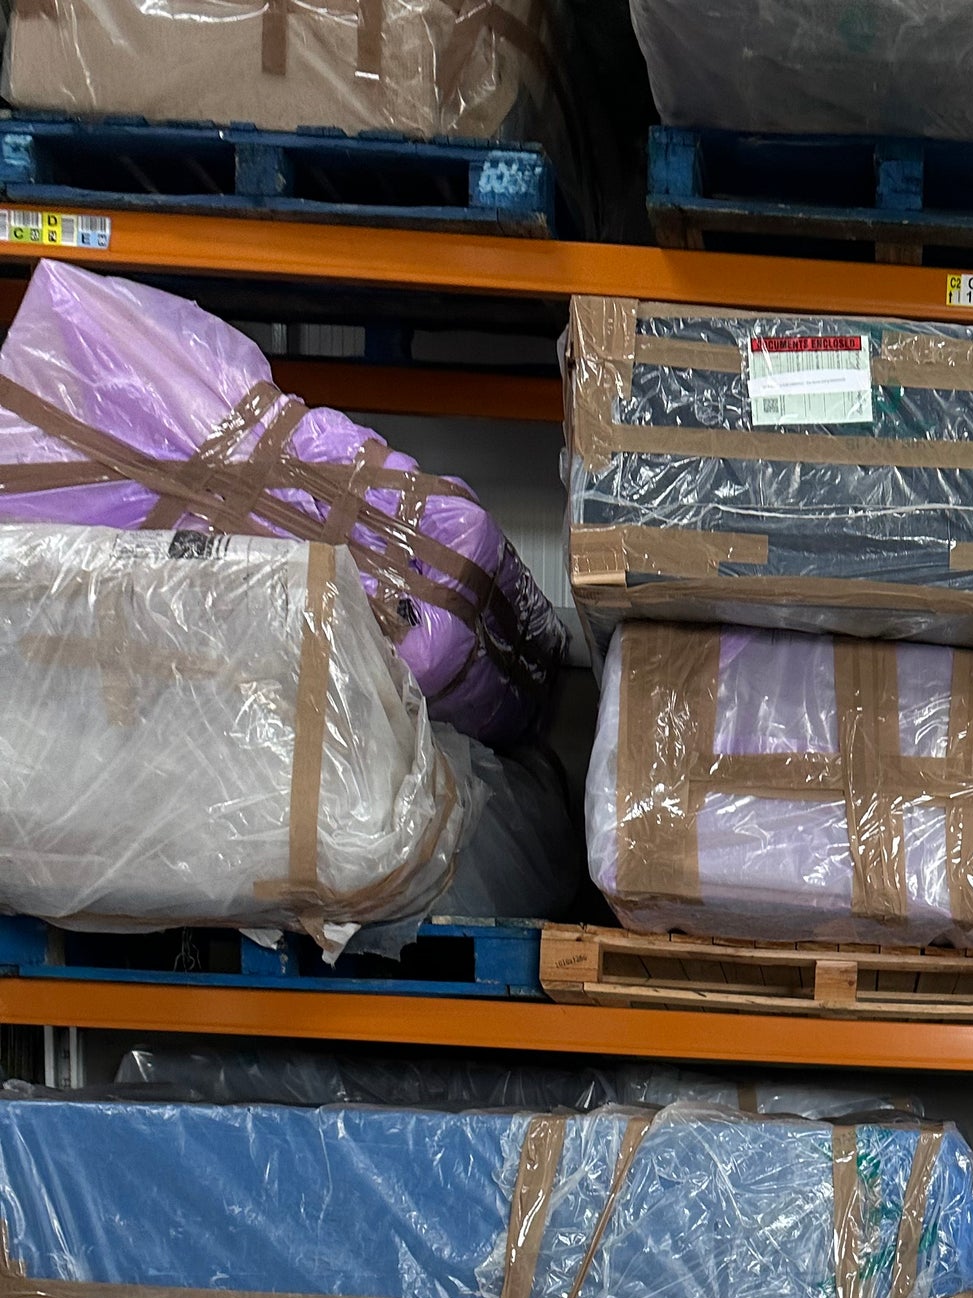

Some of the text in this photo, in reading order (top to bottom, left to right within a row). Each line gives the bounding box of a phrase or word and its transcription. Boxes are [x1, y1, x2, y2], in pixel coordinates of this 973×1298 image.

[47, 214, 58, 227] D
[13, 227, 24, 239] C
[81, 232, 91, 246] E
